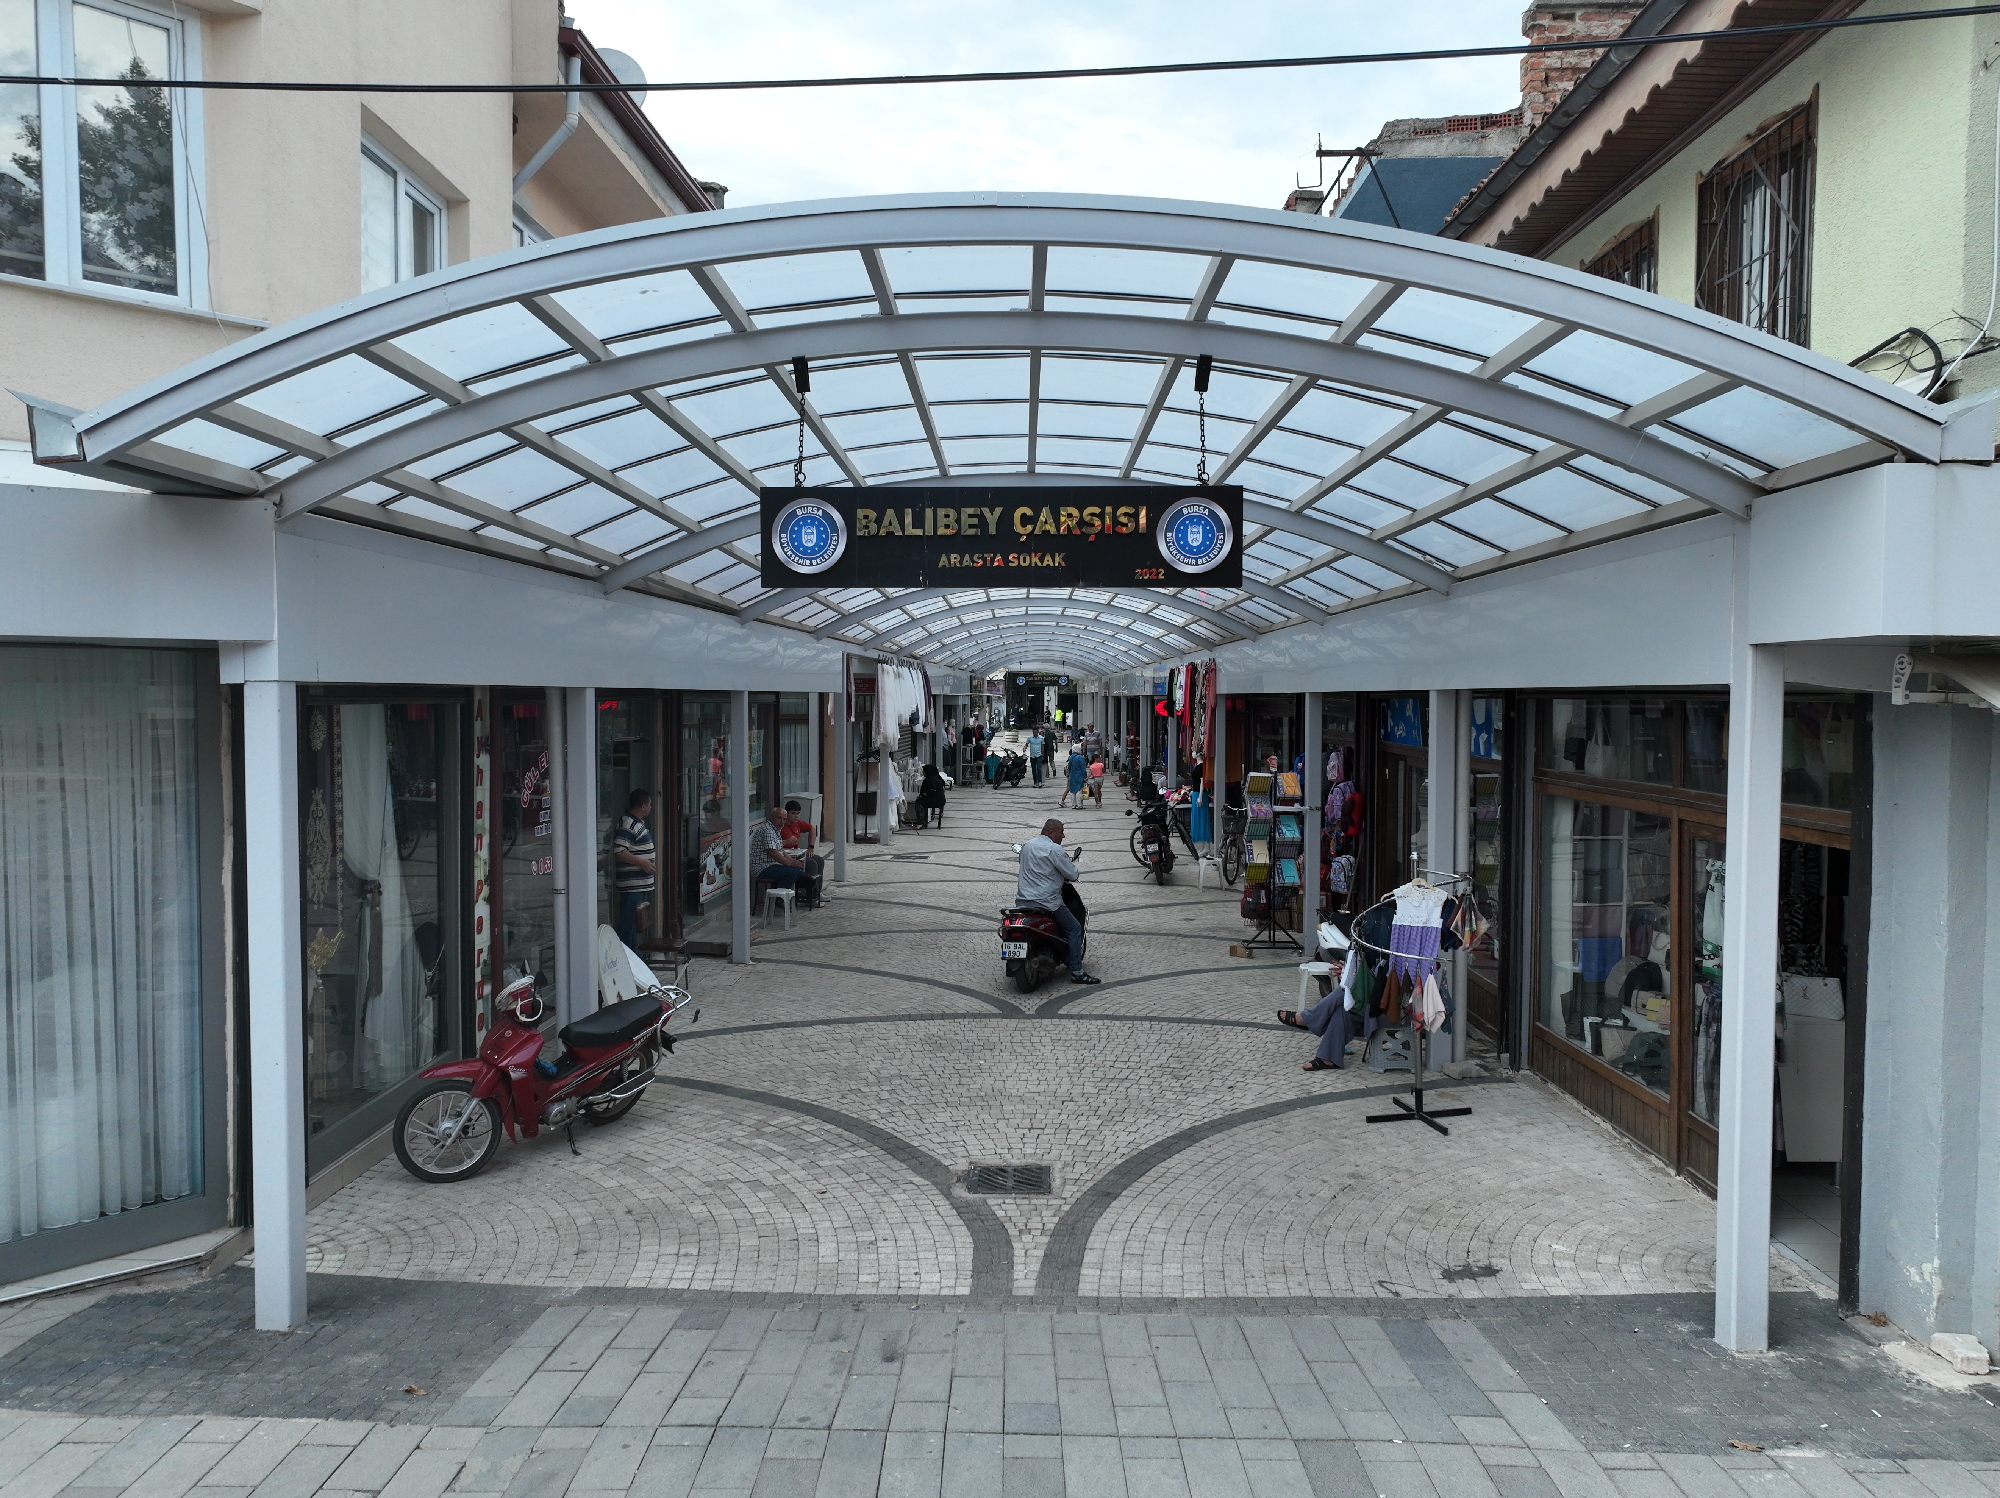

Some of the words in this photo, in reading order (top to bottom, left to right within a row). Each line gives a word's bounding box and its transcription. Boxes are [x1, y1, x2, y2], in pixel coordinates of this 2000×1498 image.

[795, 506, 823, 516] BURSA
[1182, 505, 1209, 516] BURSA
[856, 506, 1003, 535] BALIBEY
[1013, 505, 1147, 542] ÇARŞISI
[780, 533, 810, 566] BÜYÜKŞEHİR
[811, 533, 838, 566] BELEDİYESİ
[938, 553, 1005, 568] ARASTA
[1008, 552, 1067, 568] SOKAK
[1166, 532, 1196, 565] BÜYÜKŞEHİR
[1197, 532, 1224, 565] BELEDİYESİ
[1134, 568, 1165, 580] 2022
[521, 766, 540, 808] GÜL
